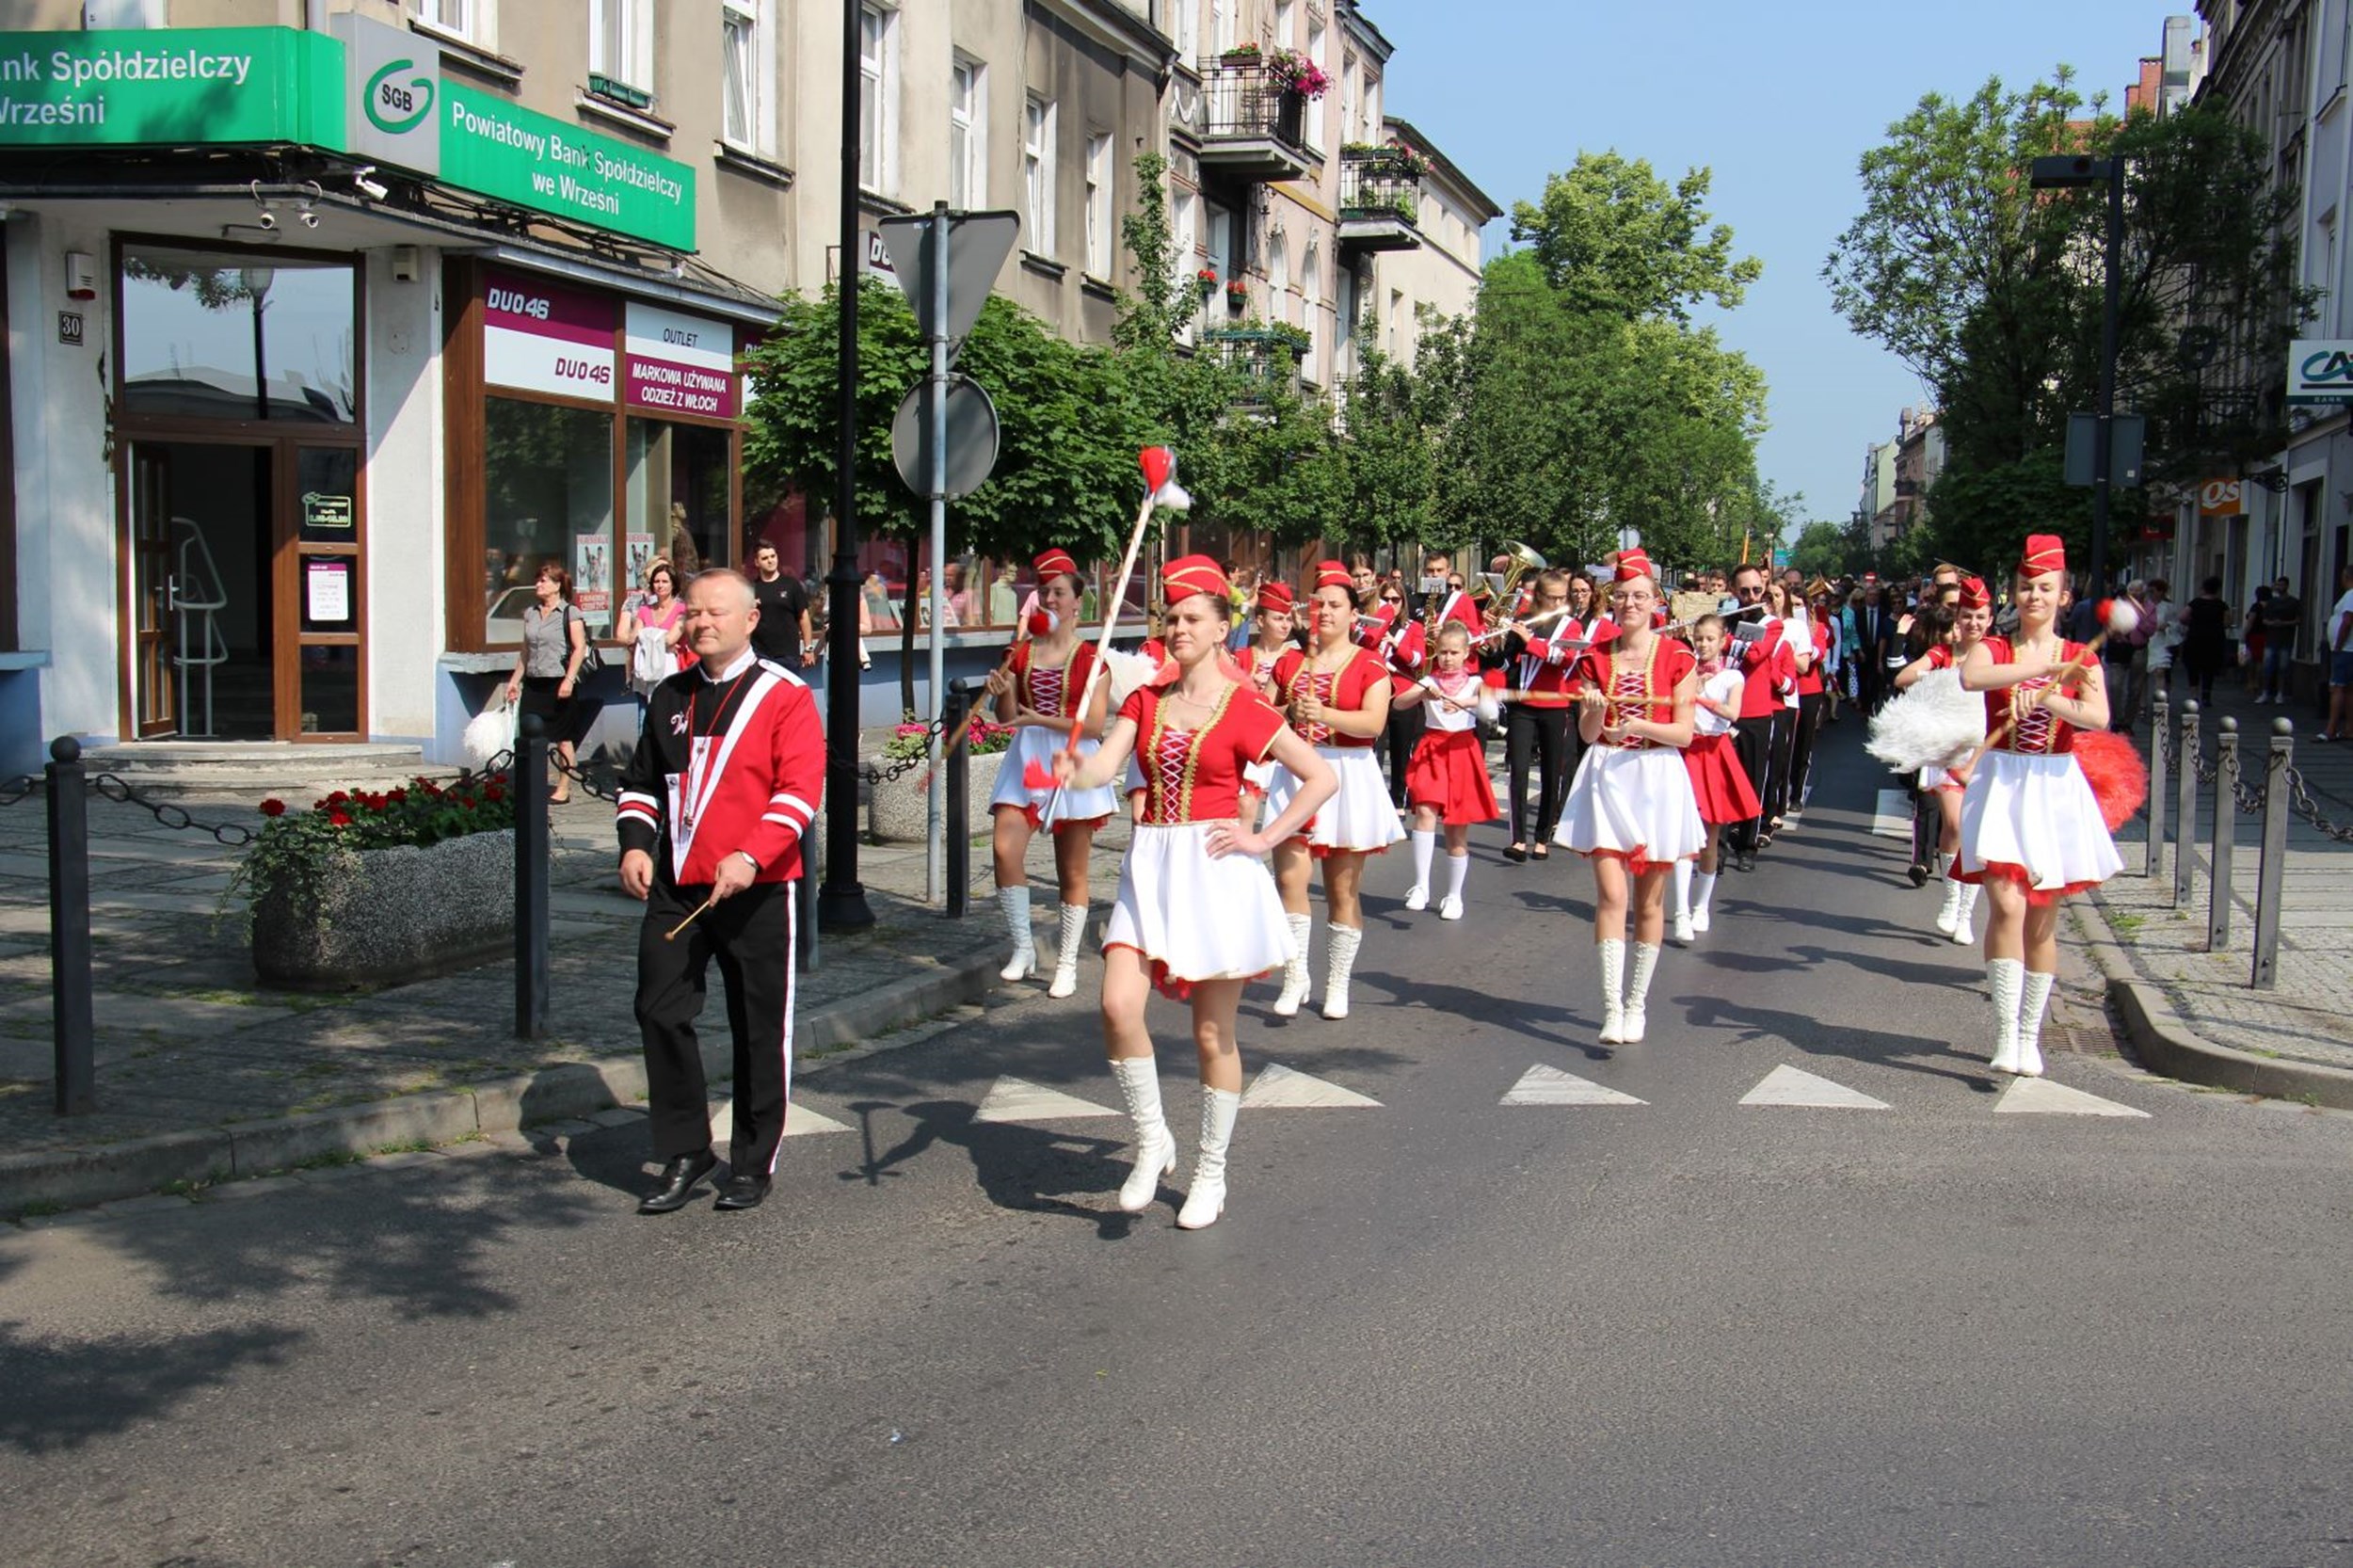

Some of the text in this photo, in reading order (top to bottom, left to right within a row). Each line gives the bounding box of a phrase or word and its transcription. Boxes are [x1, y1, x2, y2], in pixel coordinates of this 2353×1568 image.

[0, 50, 251, 88] nk Spółdzielczy
[382, 83, 412, 112] SGB
[452, 101, 682, 205] Powiatowy Bank Spółdzielczy
[532, 171, 619, 216] we Wrześni
[62, 315, 80, 337] 30
[663, 328, 698, 348] OUTLET
[632, 362, 727, 393] MARKOWA UŻYWANA
[641, 386, 718, 412] ODZIEŻ Z WŁOCH
